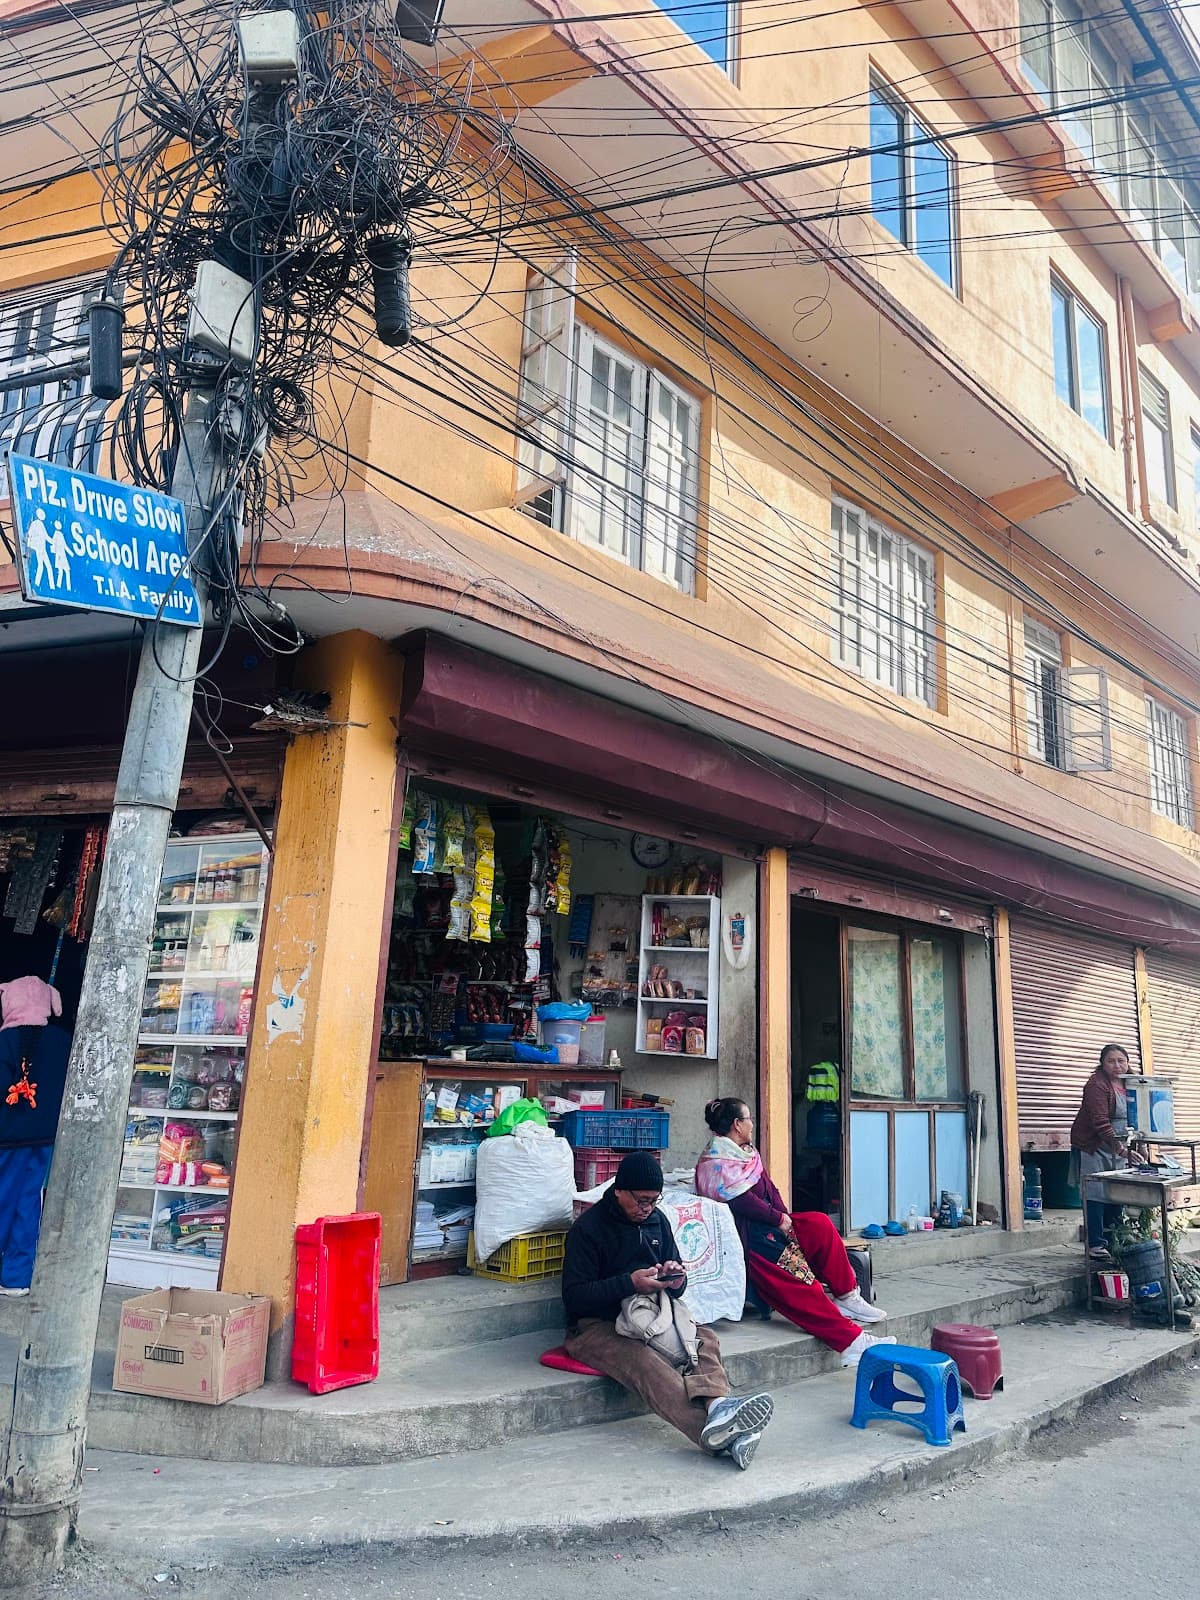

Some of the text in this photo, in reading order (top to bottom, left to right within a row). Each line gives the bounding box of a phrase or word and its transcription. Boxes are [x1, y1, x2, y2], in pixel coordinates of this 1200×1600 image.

[22, 463, 182, 535] Plz. Drive Slow
[71, 522, 139, 571] School
[93, 575, 136, 601] T.I.A.
